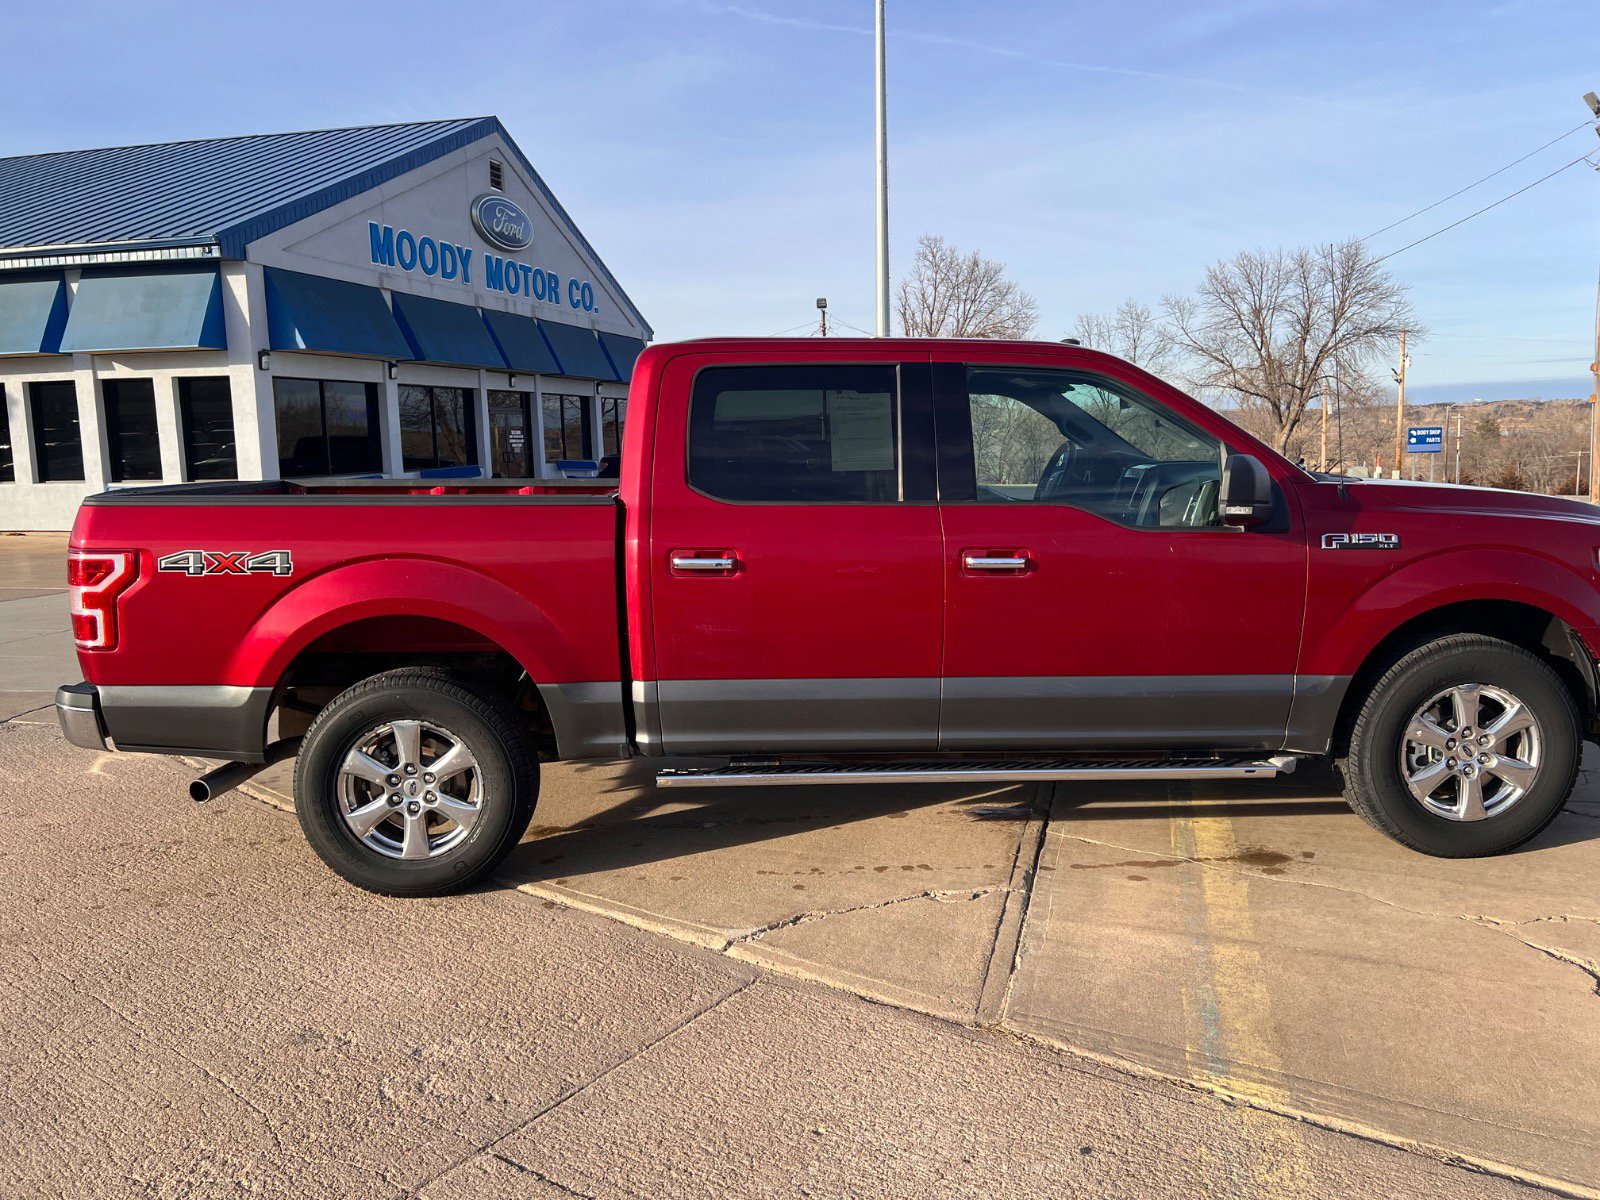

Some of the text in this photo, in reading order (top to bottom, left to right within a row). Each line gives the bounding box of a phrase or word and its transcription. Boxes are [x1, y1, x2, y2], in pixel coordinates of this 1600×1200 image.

[493, 205, 525, 240] Ford
[368, 220, 599, 314] MOODY MOTOR CO.
